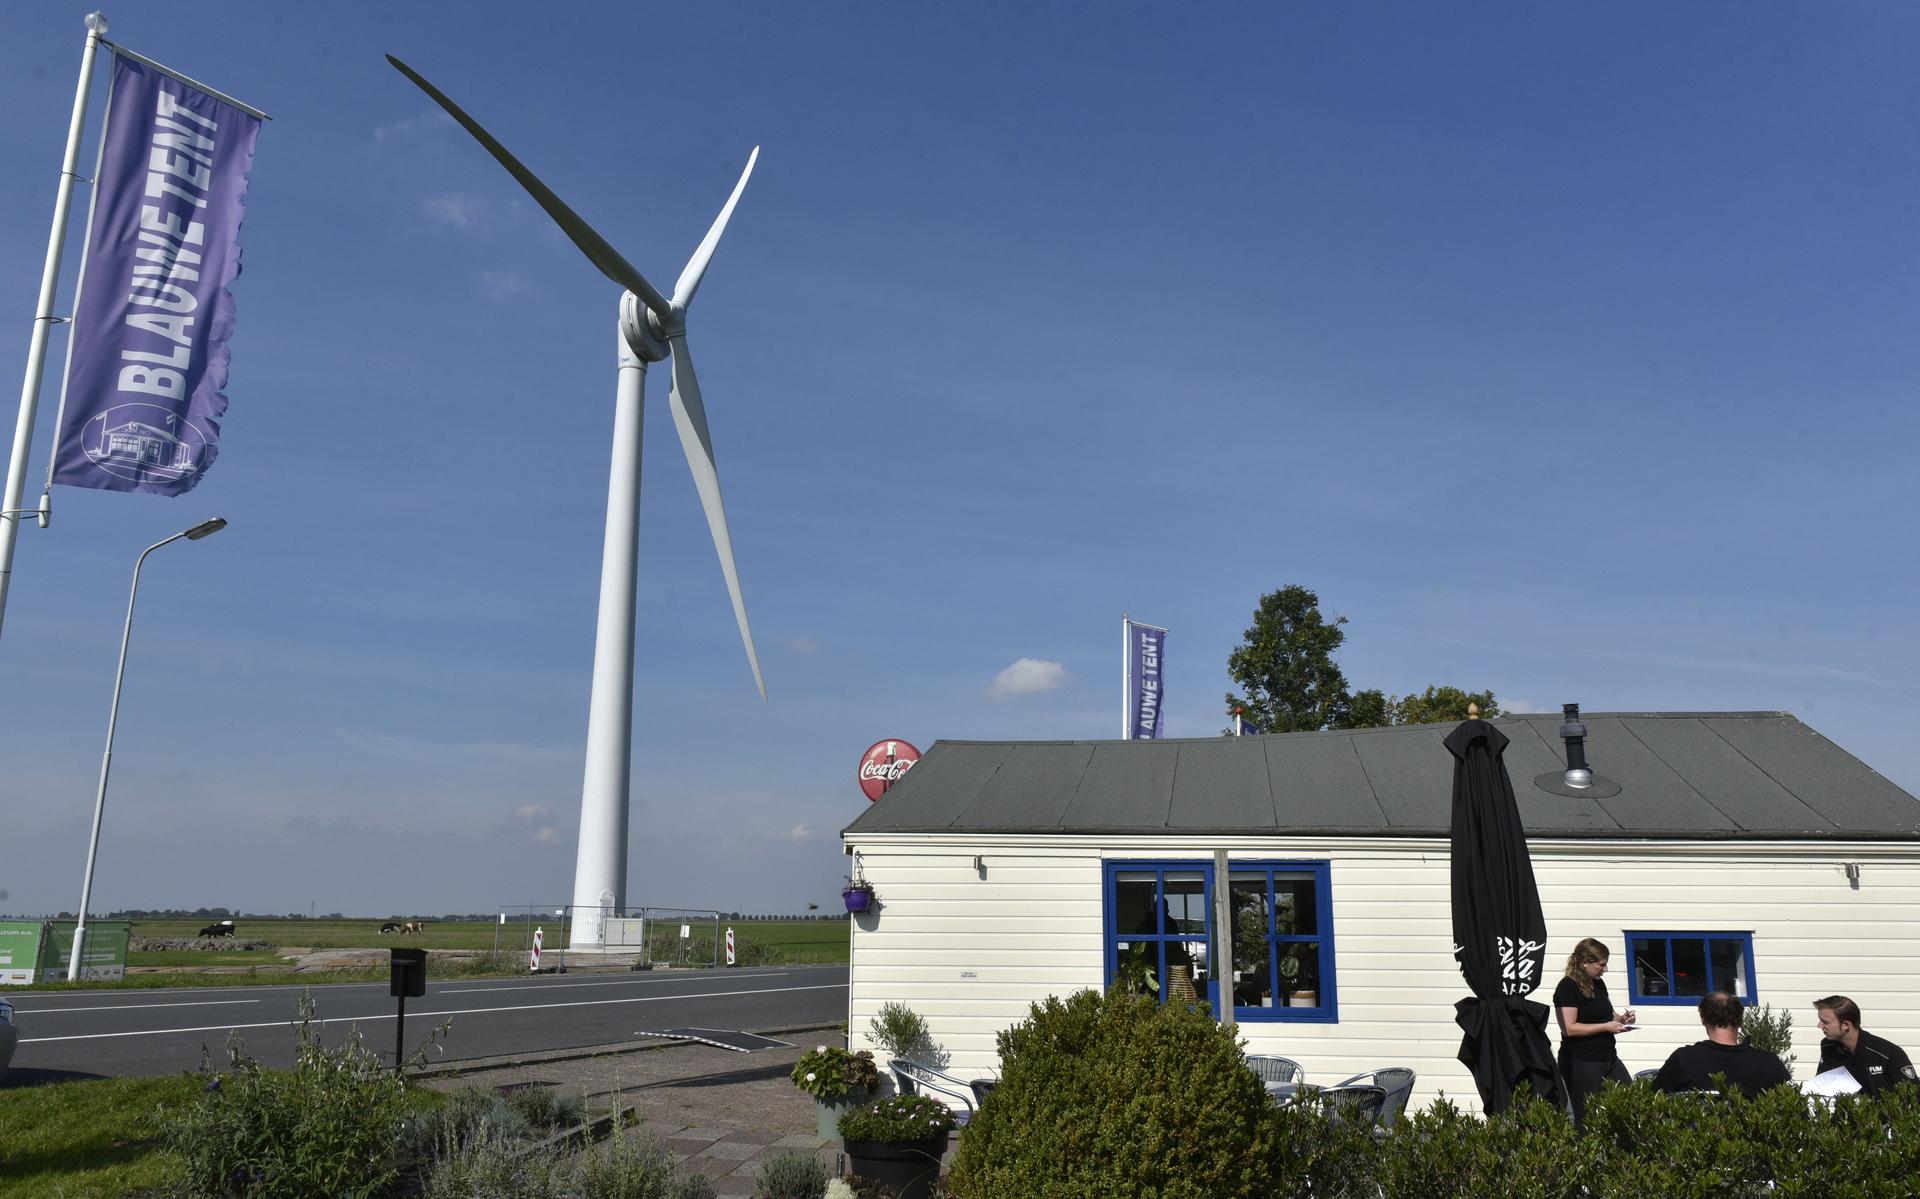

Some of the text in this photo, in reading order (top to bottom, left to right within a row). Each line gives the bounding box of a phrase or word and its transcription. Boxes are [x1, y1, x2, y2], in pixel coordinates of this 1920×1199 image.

[117, 90, 217, 400] BLAUWE TENT
[1139, 633, 1157, 740] LAUWE TENT
